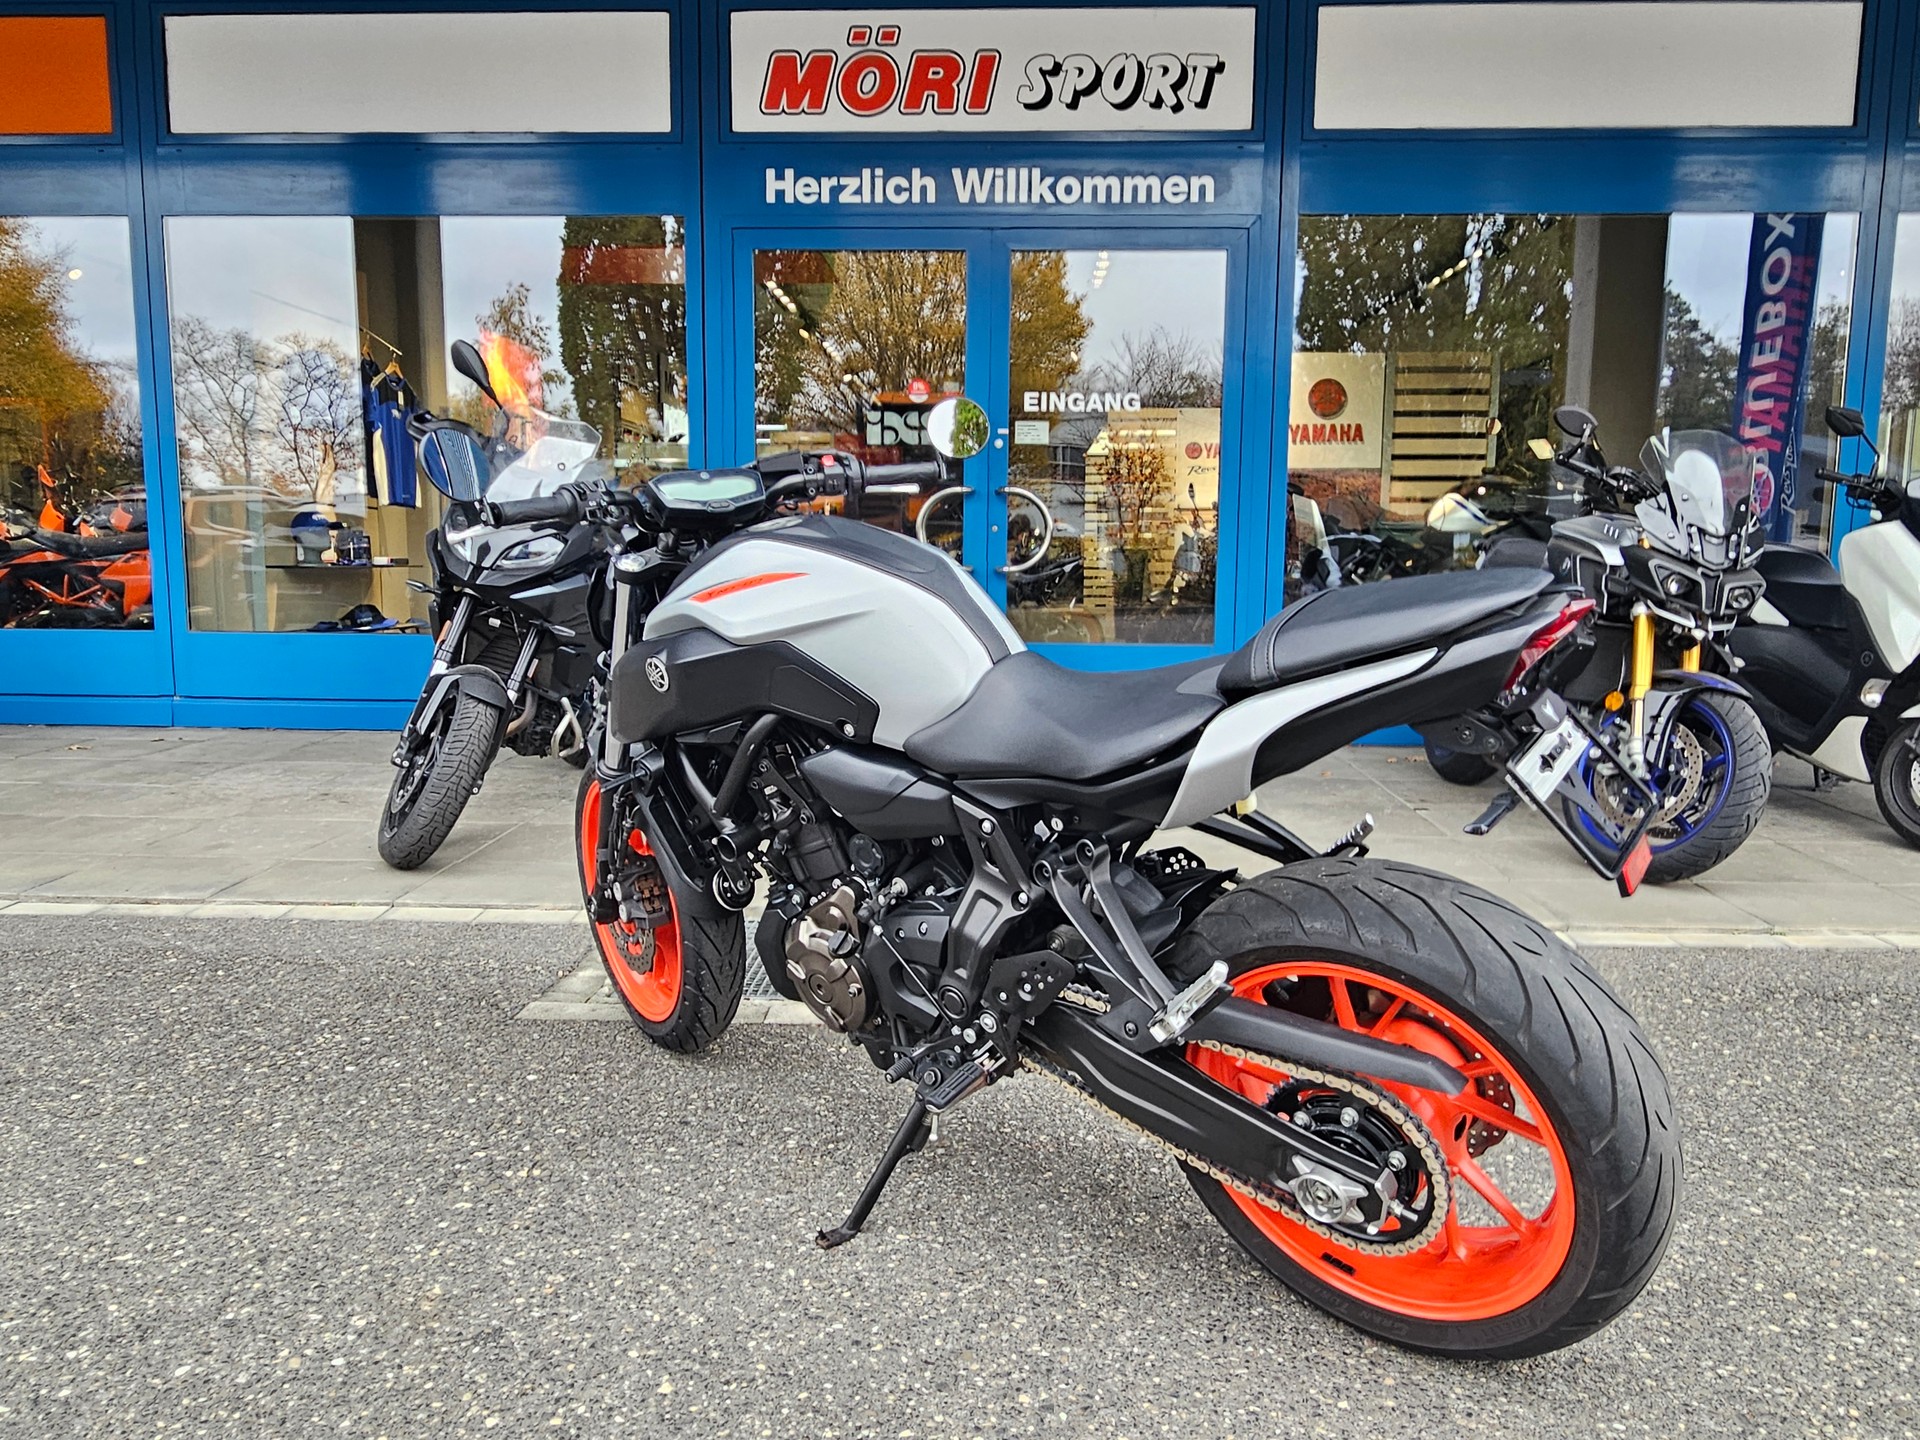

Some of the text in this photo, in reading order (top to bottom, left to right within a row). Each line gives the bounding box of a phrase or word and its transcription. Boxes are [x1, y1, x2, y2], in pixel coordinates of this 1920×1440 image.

[760, 25, 1225, 116] MÖRI SPORT
[765, 167, 1215, 204] Herzlich Willkommen
[1023, 391, 1141, 413] EINGANG
[1289, 423, 1364, 444] YAMAHA
